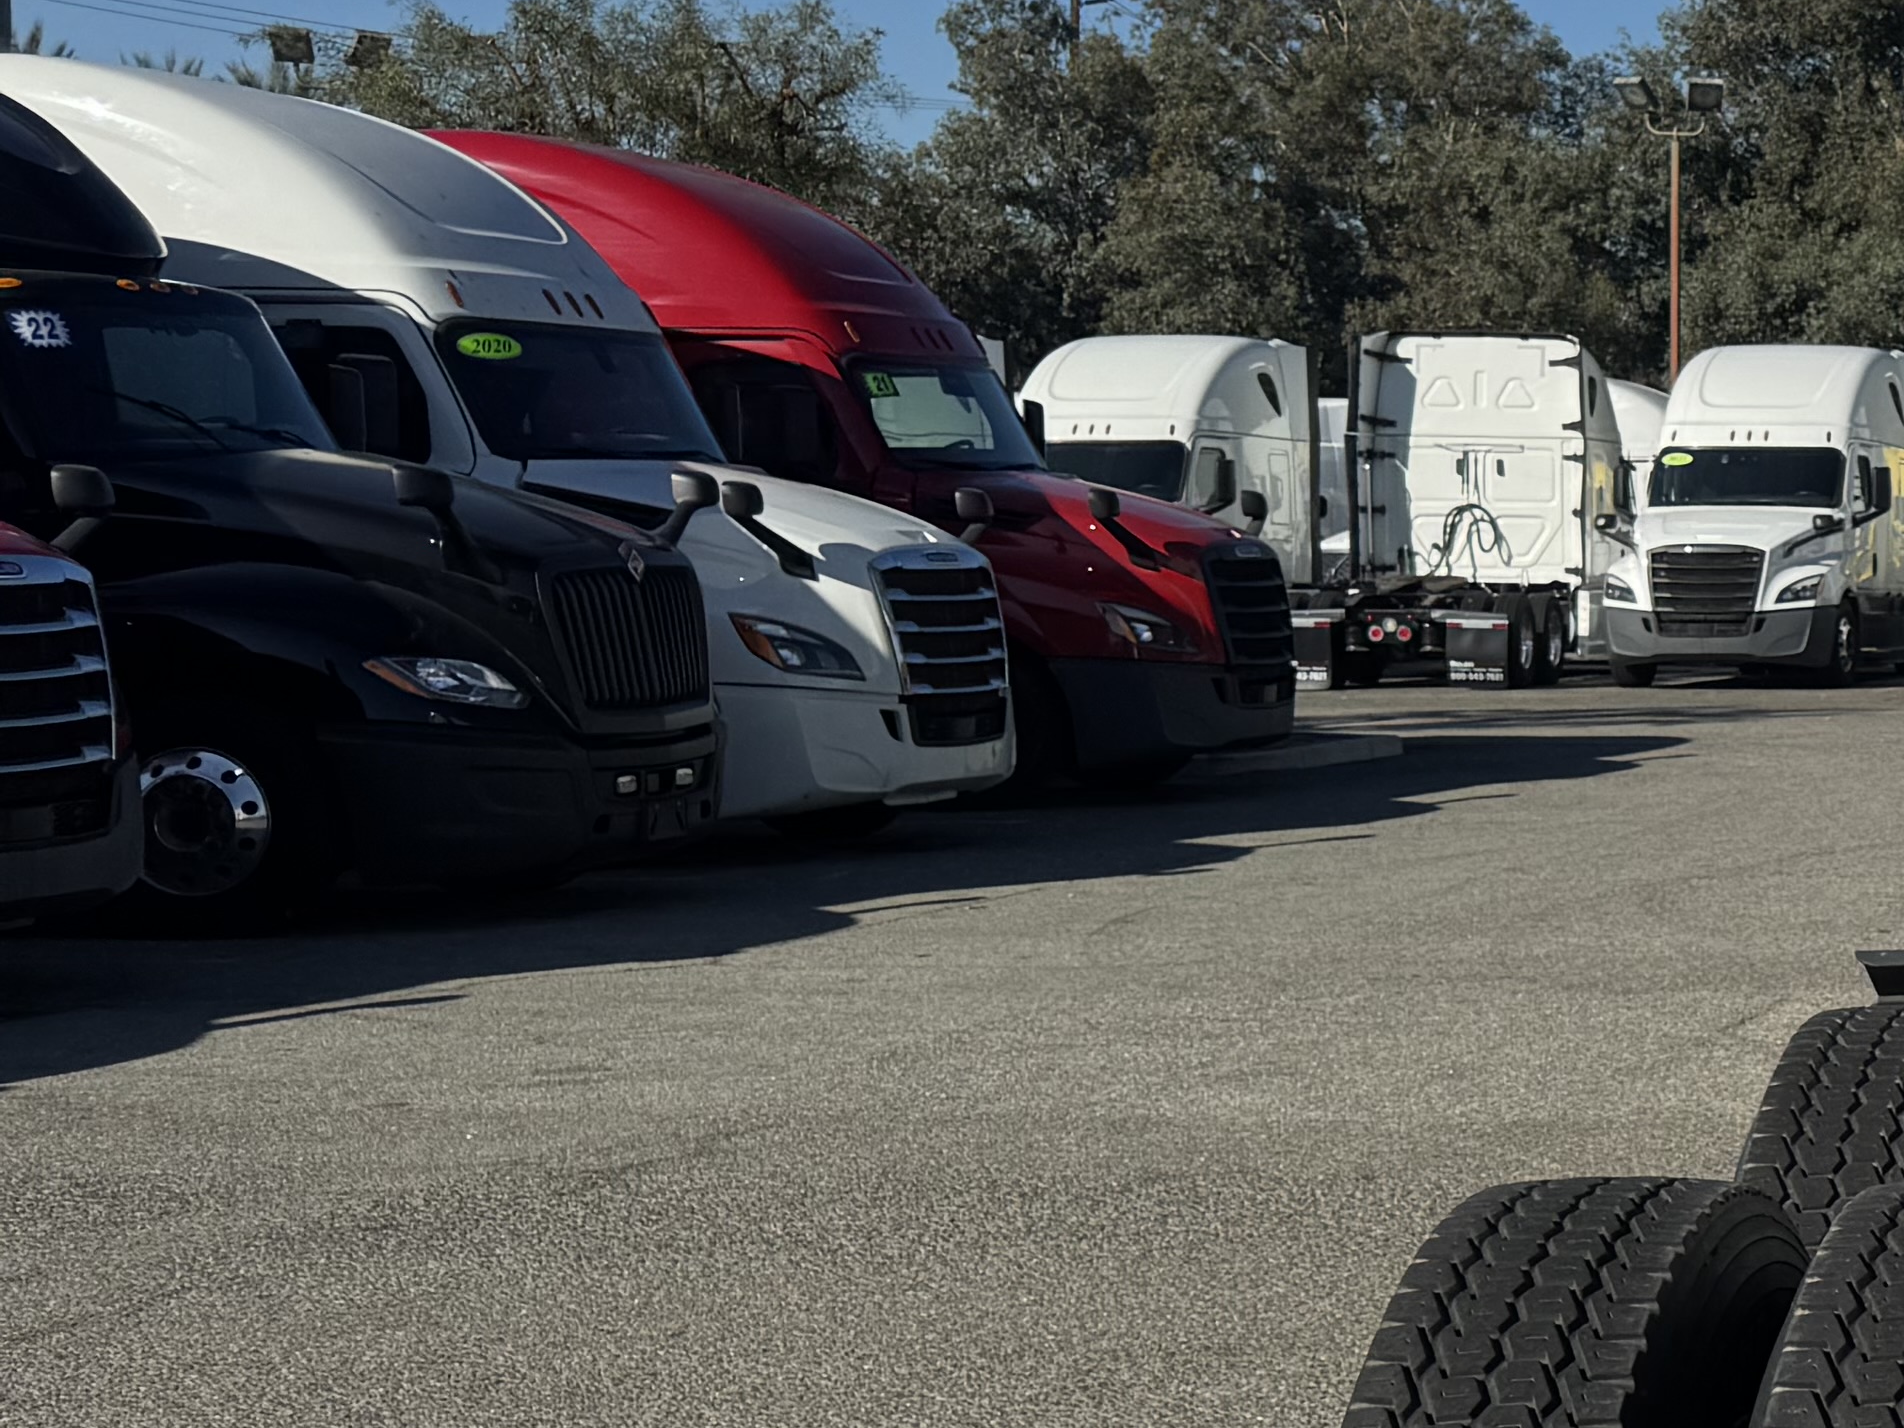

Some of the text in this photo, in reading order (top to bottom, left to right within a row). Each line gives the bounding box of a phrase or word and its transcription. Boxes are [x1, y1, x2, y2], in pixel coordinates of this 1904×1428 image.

[27, 316, 61, 341] 22
[471, 337, 512, 355] 2020
[872, 374, 890, 392] 21
